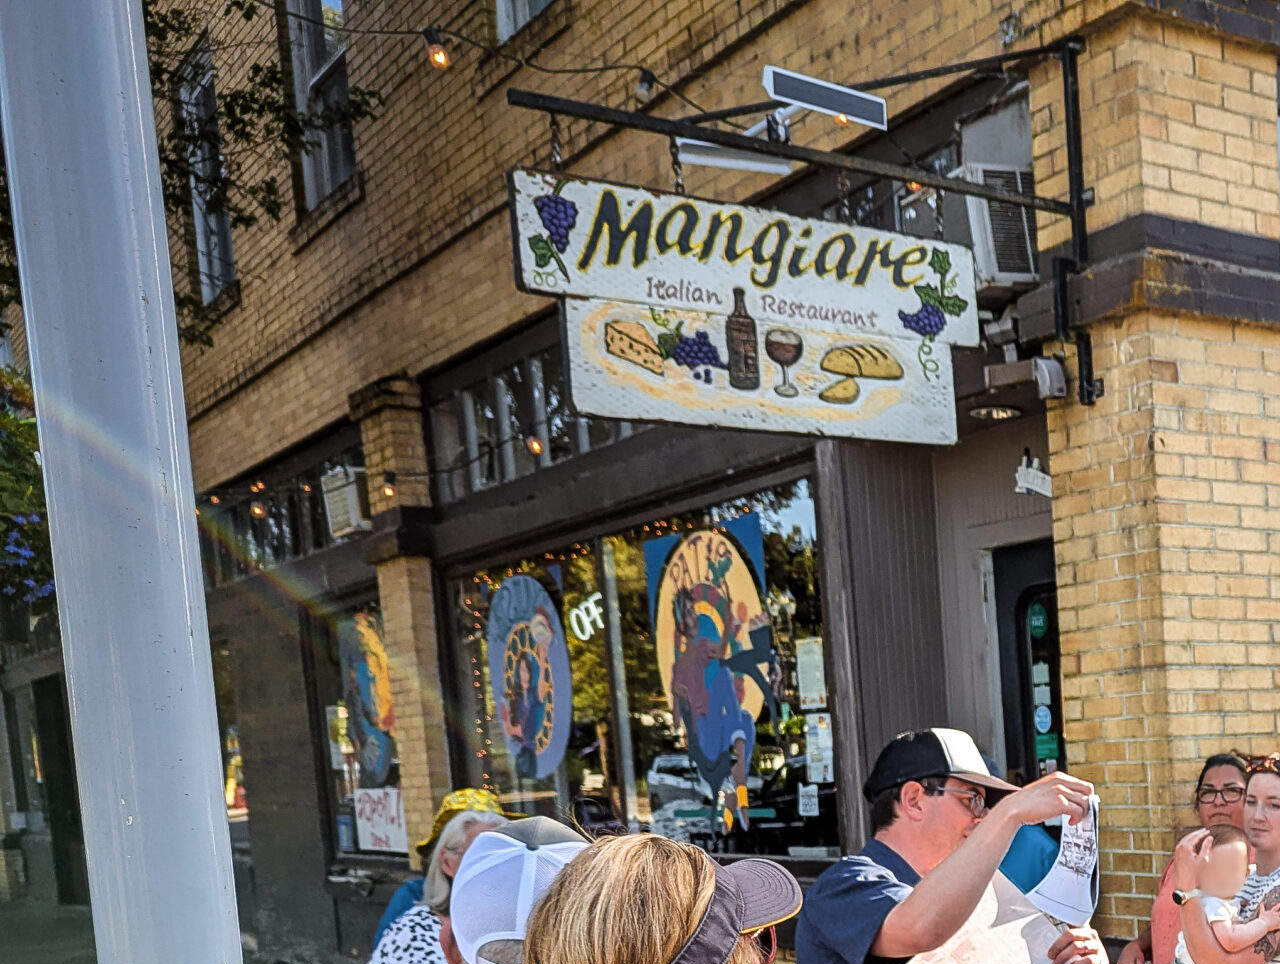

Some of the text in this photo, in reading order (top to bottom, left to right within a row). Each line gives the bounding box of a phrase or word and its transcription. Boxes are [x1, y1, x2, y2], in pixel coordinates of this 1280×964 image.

[577, 188, 929, 290] Mangiare
[646, 276, 880, 328] Italian Restaurant
